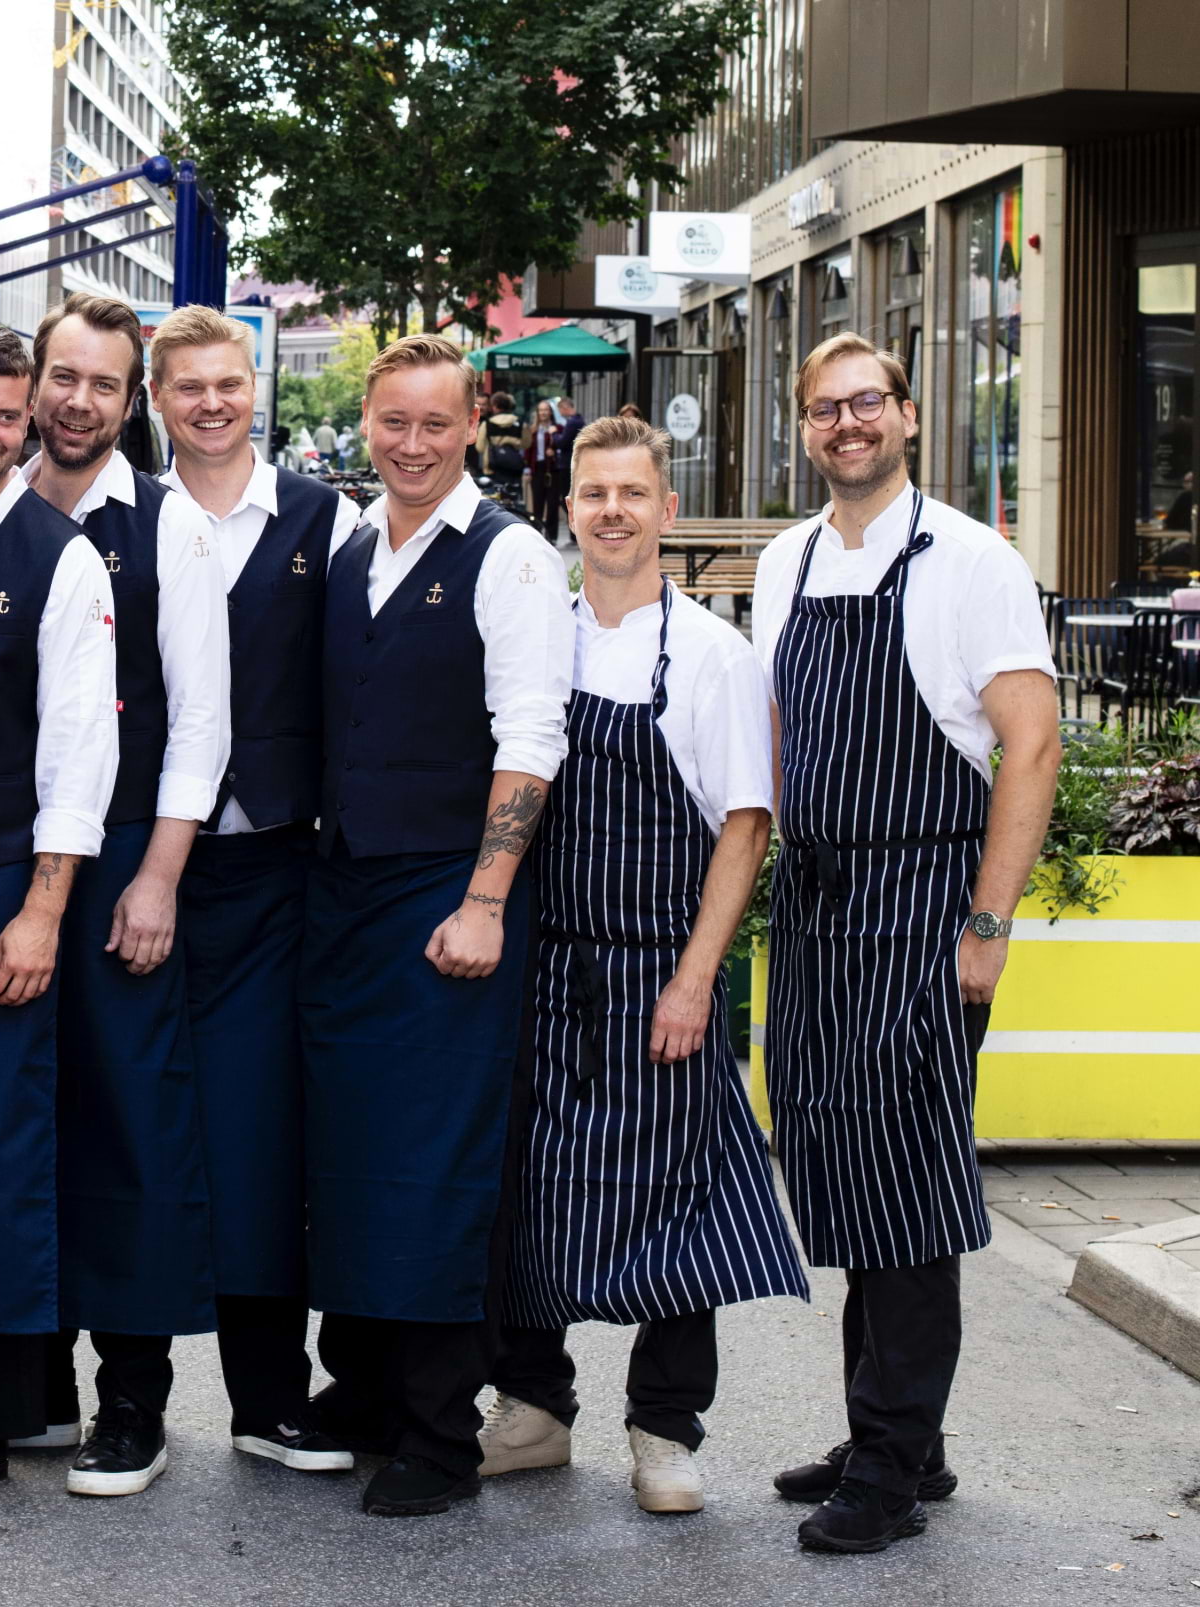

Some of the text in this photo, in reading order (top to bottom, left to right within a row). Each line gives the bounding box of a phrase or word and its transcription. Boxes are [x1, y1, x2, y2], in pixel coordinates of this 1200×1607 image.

[682, 247, 718, 255] GELATO
[511, 357, 543, 367] PHIL'S
[1156, 385, 1170, 421] 19
